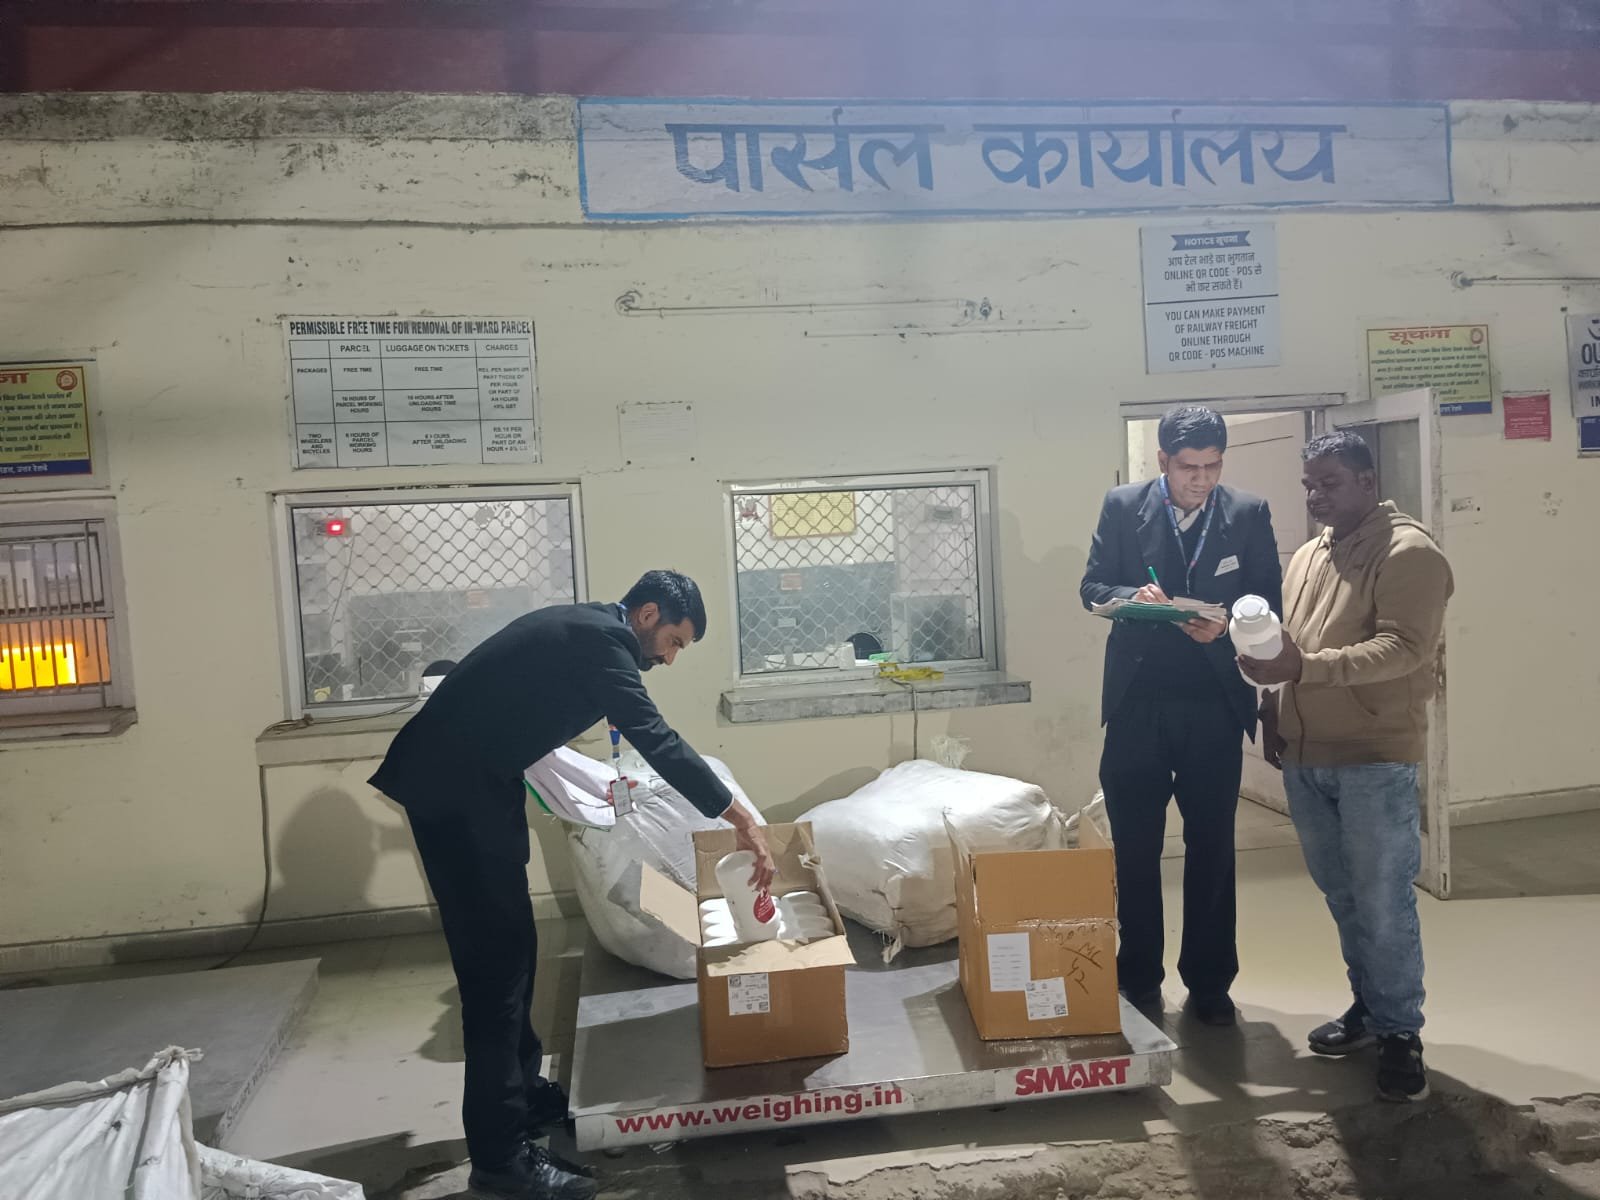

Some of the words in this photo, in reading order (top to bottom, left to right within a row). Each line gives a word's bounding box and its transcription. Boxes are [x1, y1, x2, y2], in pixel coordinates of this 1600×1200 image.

[664, 106, 946, 192] पार्सल
[972, 109, 1348, 189] कार्यालय
[1184, 238, 1215, 247] NOTICE
[1168, 256, 1182, 266] आप
[1183, 254, 1197, 266] रेल
[1215, 254, 1226, 264] का
[1227, 252, 1255, 266] भुगतान
[1164, 270, 1194, 281] ONLINE
[1208, 267, 1230, 277] CODE
[1236, 265, 1253, 276] POS
[1254, 262, 1262, 275] से
[1185, 280, 1196, 293] भी
[1198, 281, 1210, 292] कर
[1212, 279, 1232, 291] सकते
[1165, 312, 1181, 321] YOU
[1184, 309, 1200, 320] CAN
[1202, 307, 1225, 319] MAKE
[1227, 305, 1265, 317] PAYMENT
[289, 321, 345, 335] PERMISSIBLE
[347, 321, 369, 334] FREE
[370, 321, 391, 334] TIME
[393, 320, 409, 334] FOR
[411, 321, 450, 334] REMOVAL
[452, 320, 462, 334] OF
[464, 320, 499, 334] IN-WARD
[501, 320, 531, 334] PARCEL
[1175, 324, 1185, 334] OF
[1187, 321, 1222, 334] RAILWAY
[1224, 319, 1258, 330] FREIGHT
[1181, 336, 1211, 347] ONLINE
[1212, 333, 1251, 345] THROUGH
[1387, 329, 1451, 345] सूचना
[340, 344, 370, 352] PARCEL
[385, 344, 423, 352] LUGGAGE
[424, 344, 436, 352] ON
[438, 344, 469, 352] TICKETS
[1182, 350, 1202, 360] CODE
[1210, 348, 1226, 358] POS
[1228, 345, 1265, 357] MACHINE
[1015, 1058, 1131, 1096] SMART
[615, 1086, 903, 1134] www.weighing.in
